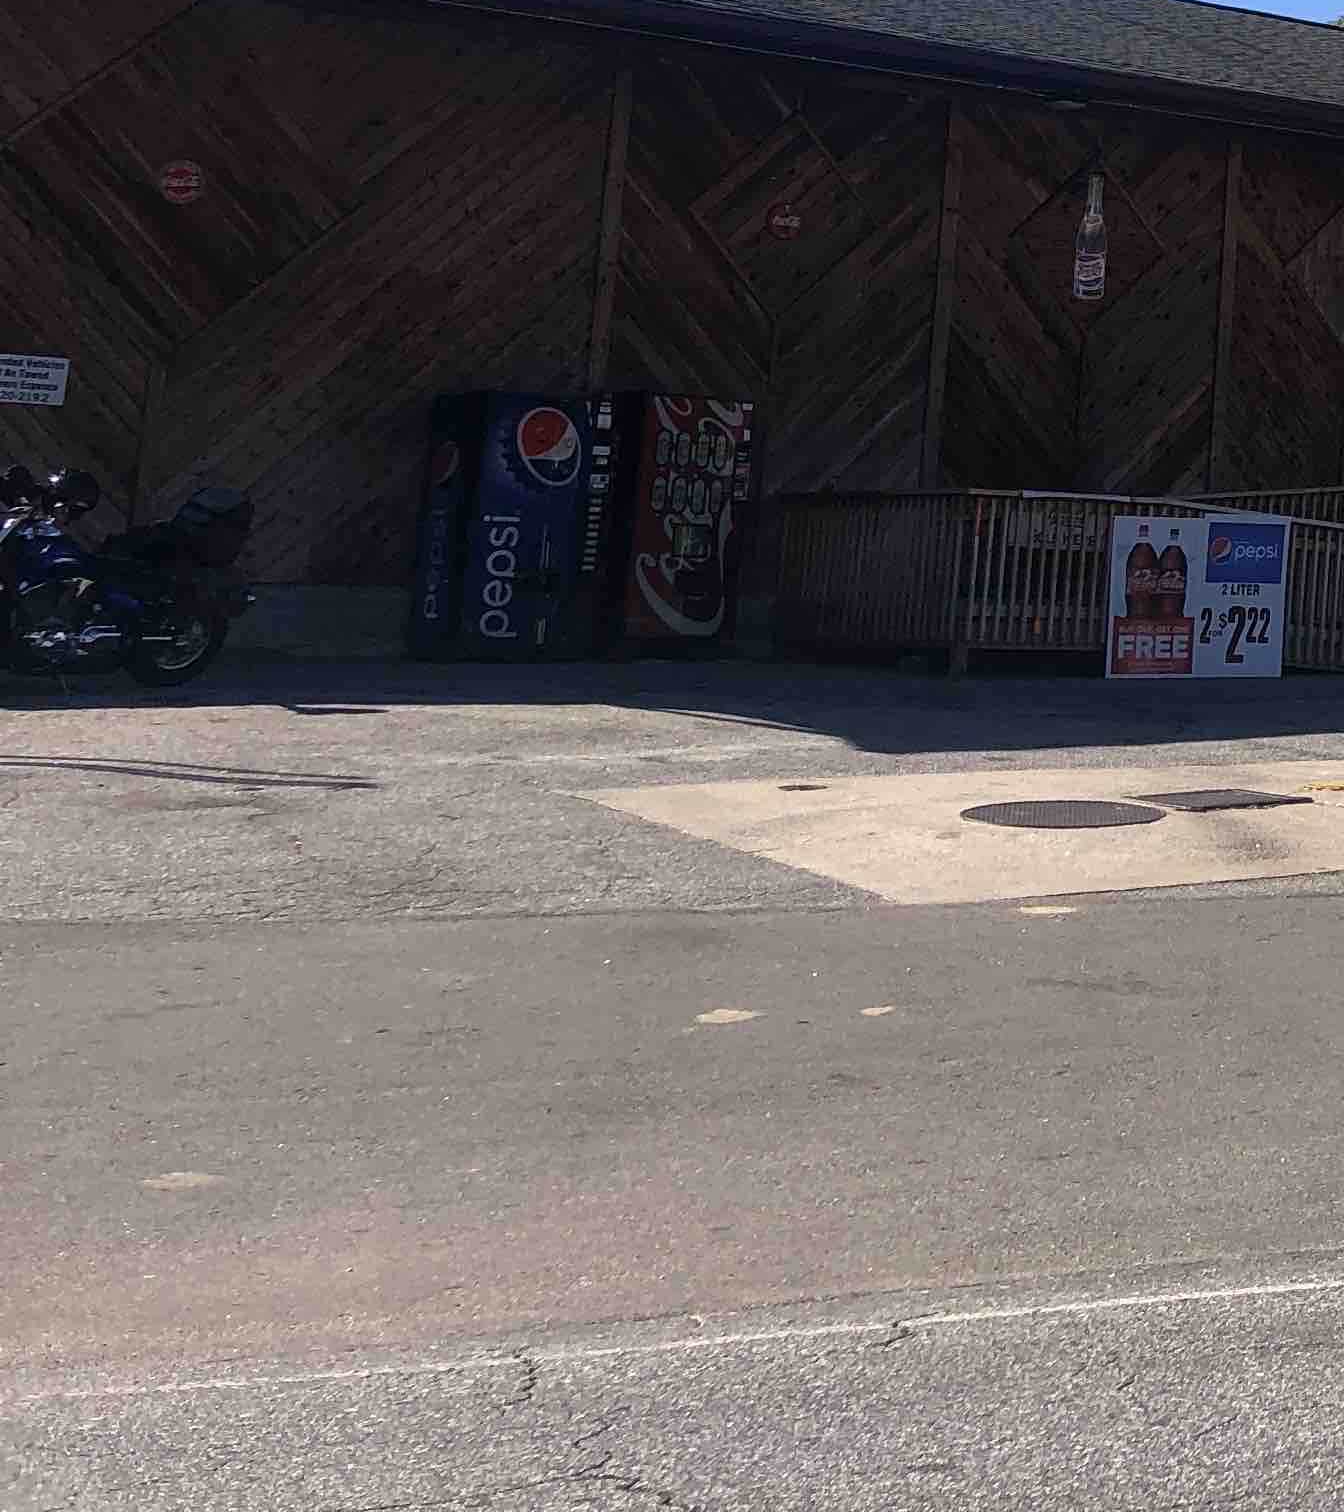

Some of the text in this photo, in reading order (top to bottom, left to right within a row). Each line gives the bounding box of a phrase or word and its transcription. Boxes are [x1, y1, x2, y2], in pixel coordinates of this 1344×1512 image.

[1235, 544, 1281, 561] pepsi
[479, 512, 521, 639] pepsi
[1221, 584, 1260, 597] 2 LITER
[1200, 607, 1213, 644] 2
[1117, 634, 1190, 660] FREE
